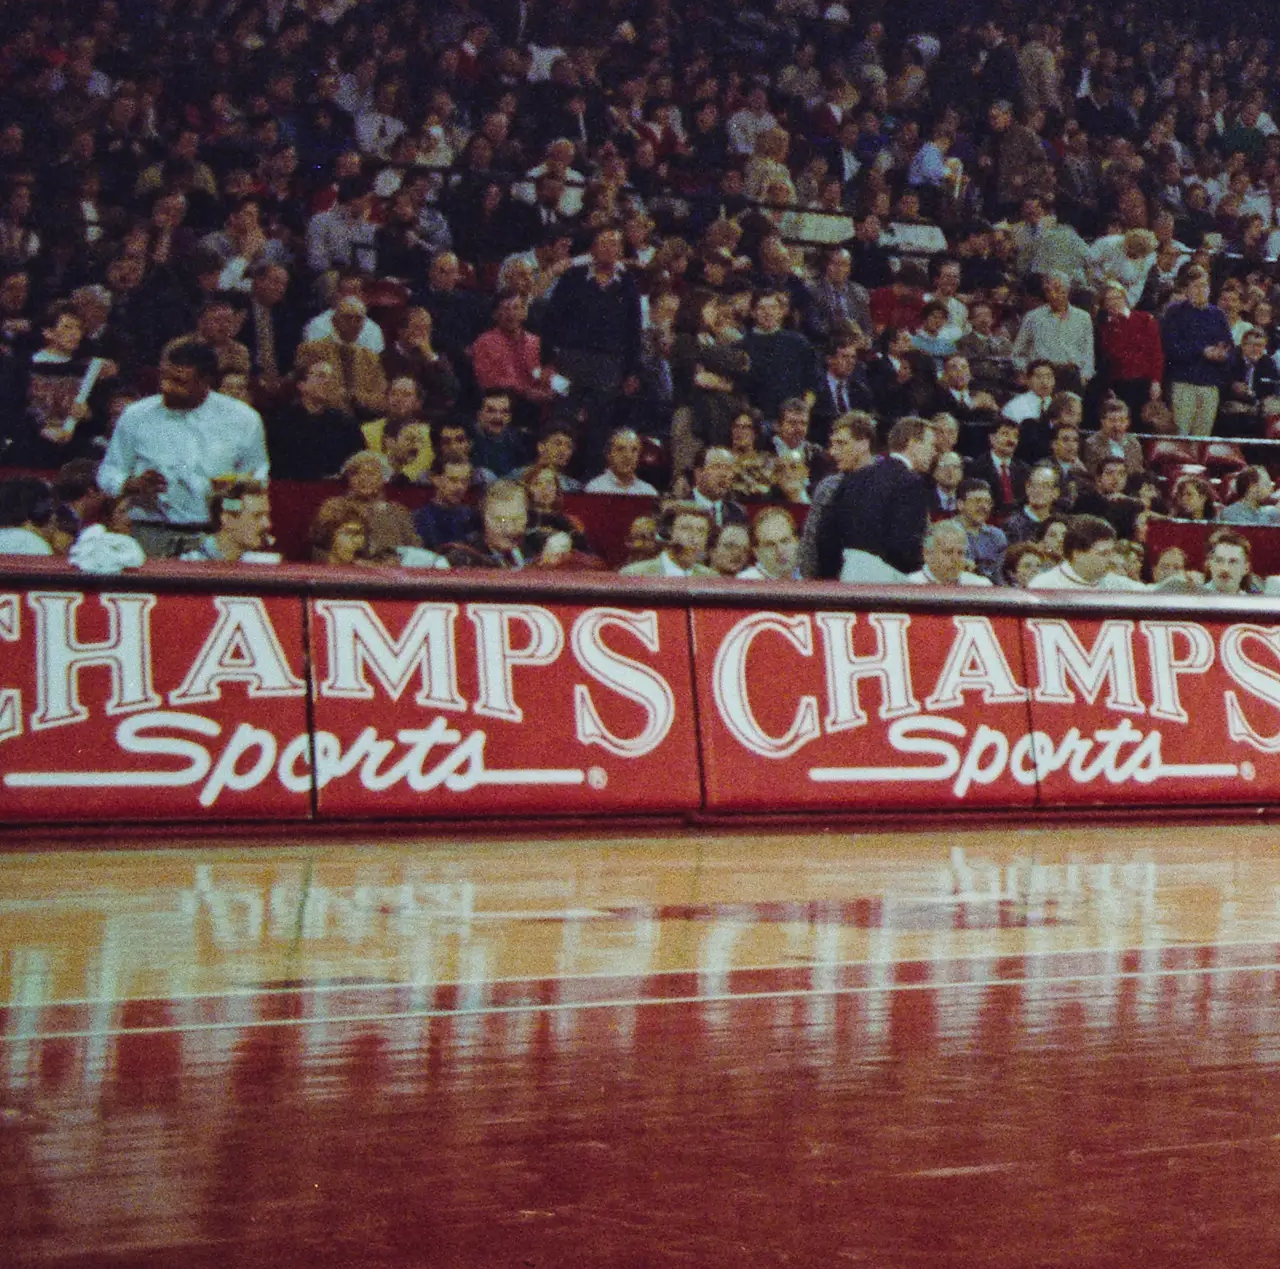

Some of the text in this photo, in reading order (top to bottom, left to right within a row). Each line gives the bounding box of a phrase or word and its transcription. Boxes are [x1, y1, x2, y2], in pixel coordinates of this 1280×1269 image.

[0, 590, 675, 759] HAMPS
[114, 709, 490, 807] Sports
[887, 715, 1166, 798] Sports
